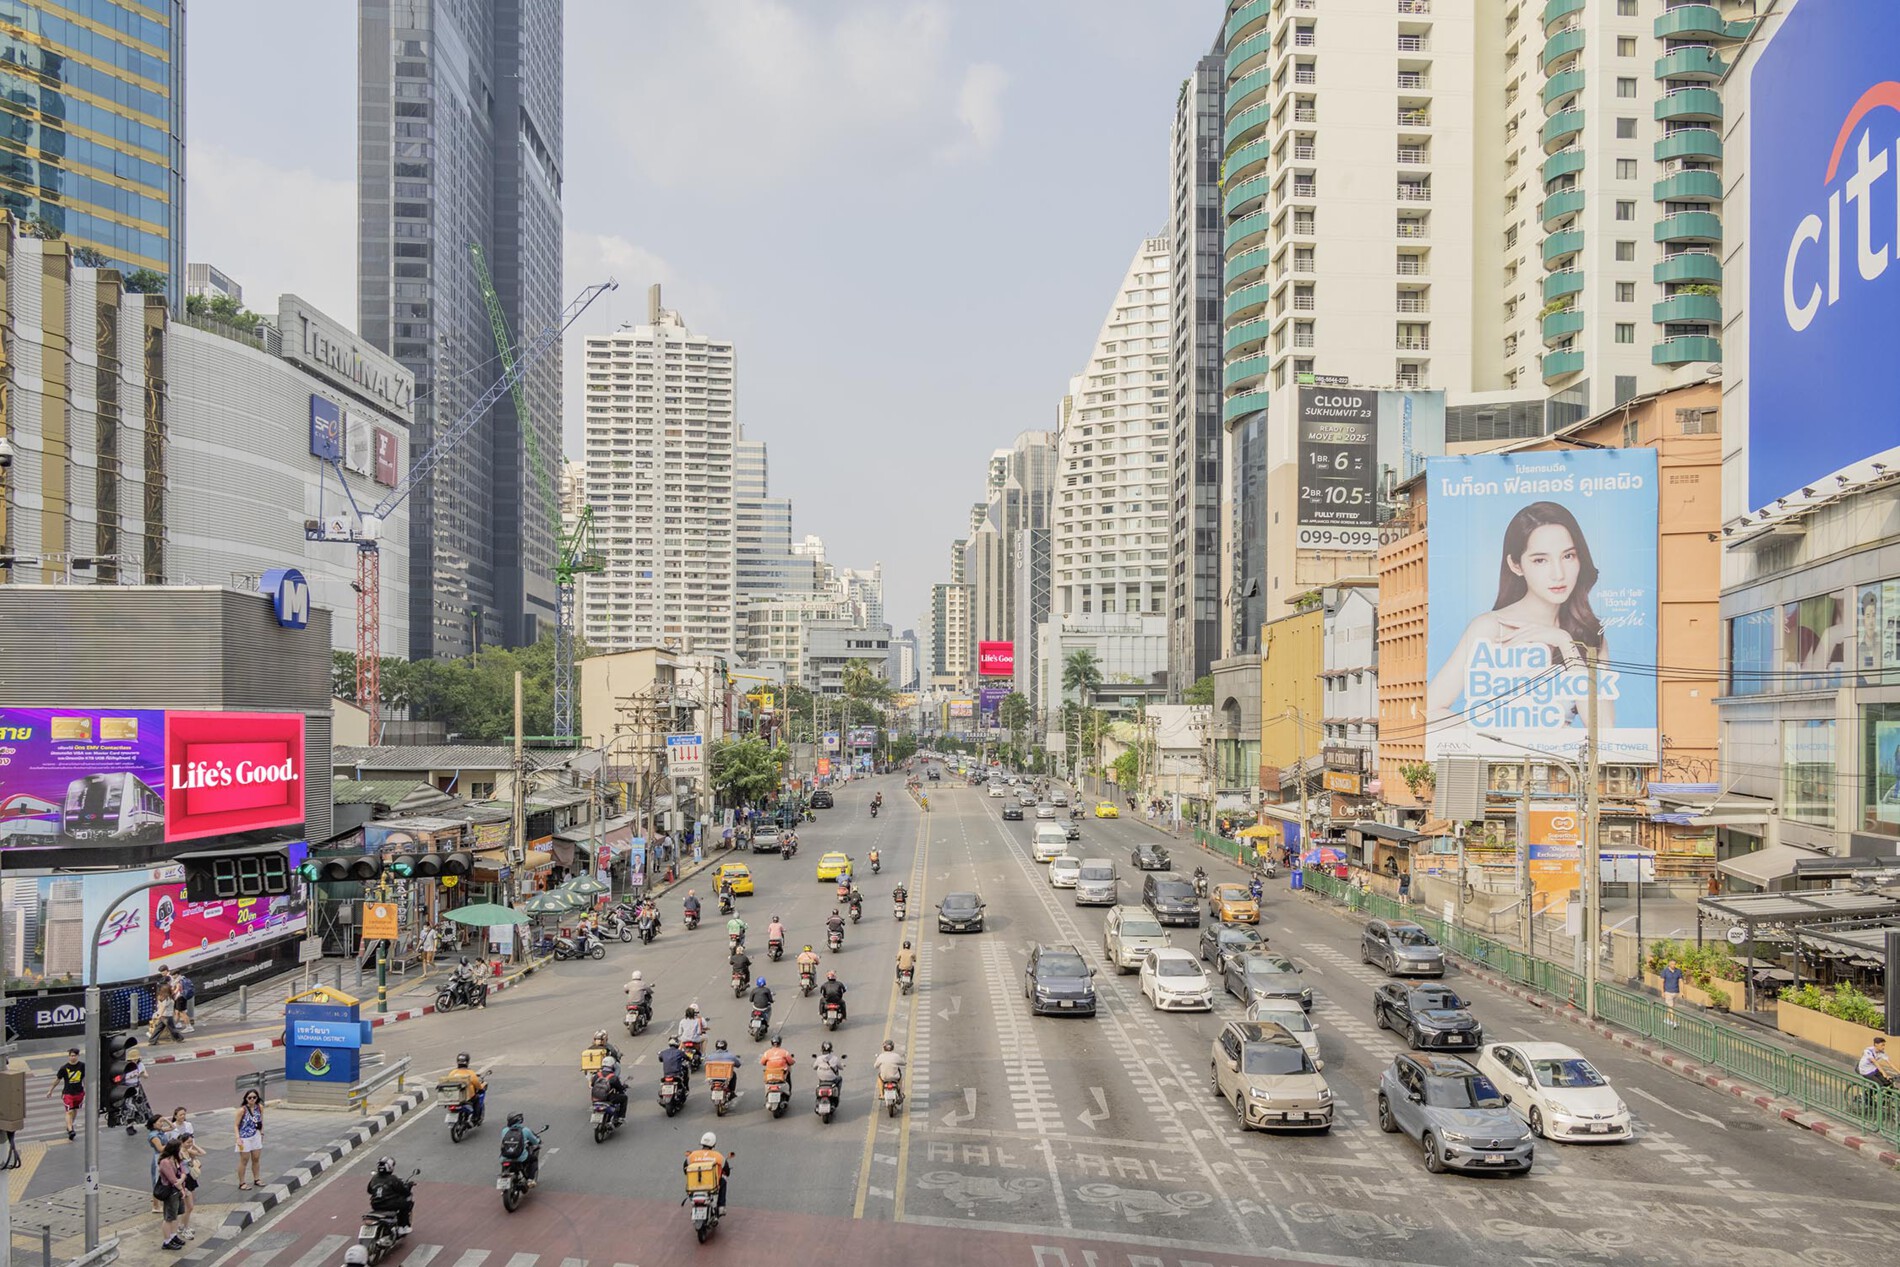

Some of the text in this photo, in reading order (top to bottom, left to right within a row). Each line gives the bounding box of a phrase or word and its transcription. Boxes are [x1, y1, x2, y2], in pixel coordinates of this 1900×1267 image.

[1305, 408, 1372, 418] SUKHUMVIT 23
[1314, 396, 1362, 408] CLOUD
[1308, 433, 1334, 441] MOVE
[1334, 452, 1349, 470] 6
[1325, 486, 1364, 505] 10.5
[1442, 472, 1644, 497] โบท็อก ฟิลเลอร์ ดูแลผิว
[282, 579, 308, 624] M
[1470, 642, 1547, 669] Aura
[1469, 670, 1615, 705] Bangkok
[1470, 699, 1562, 728] Clinic
[172, 759, 298, 790] Life's Good.
